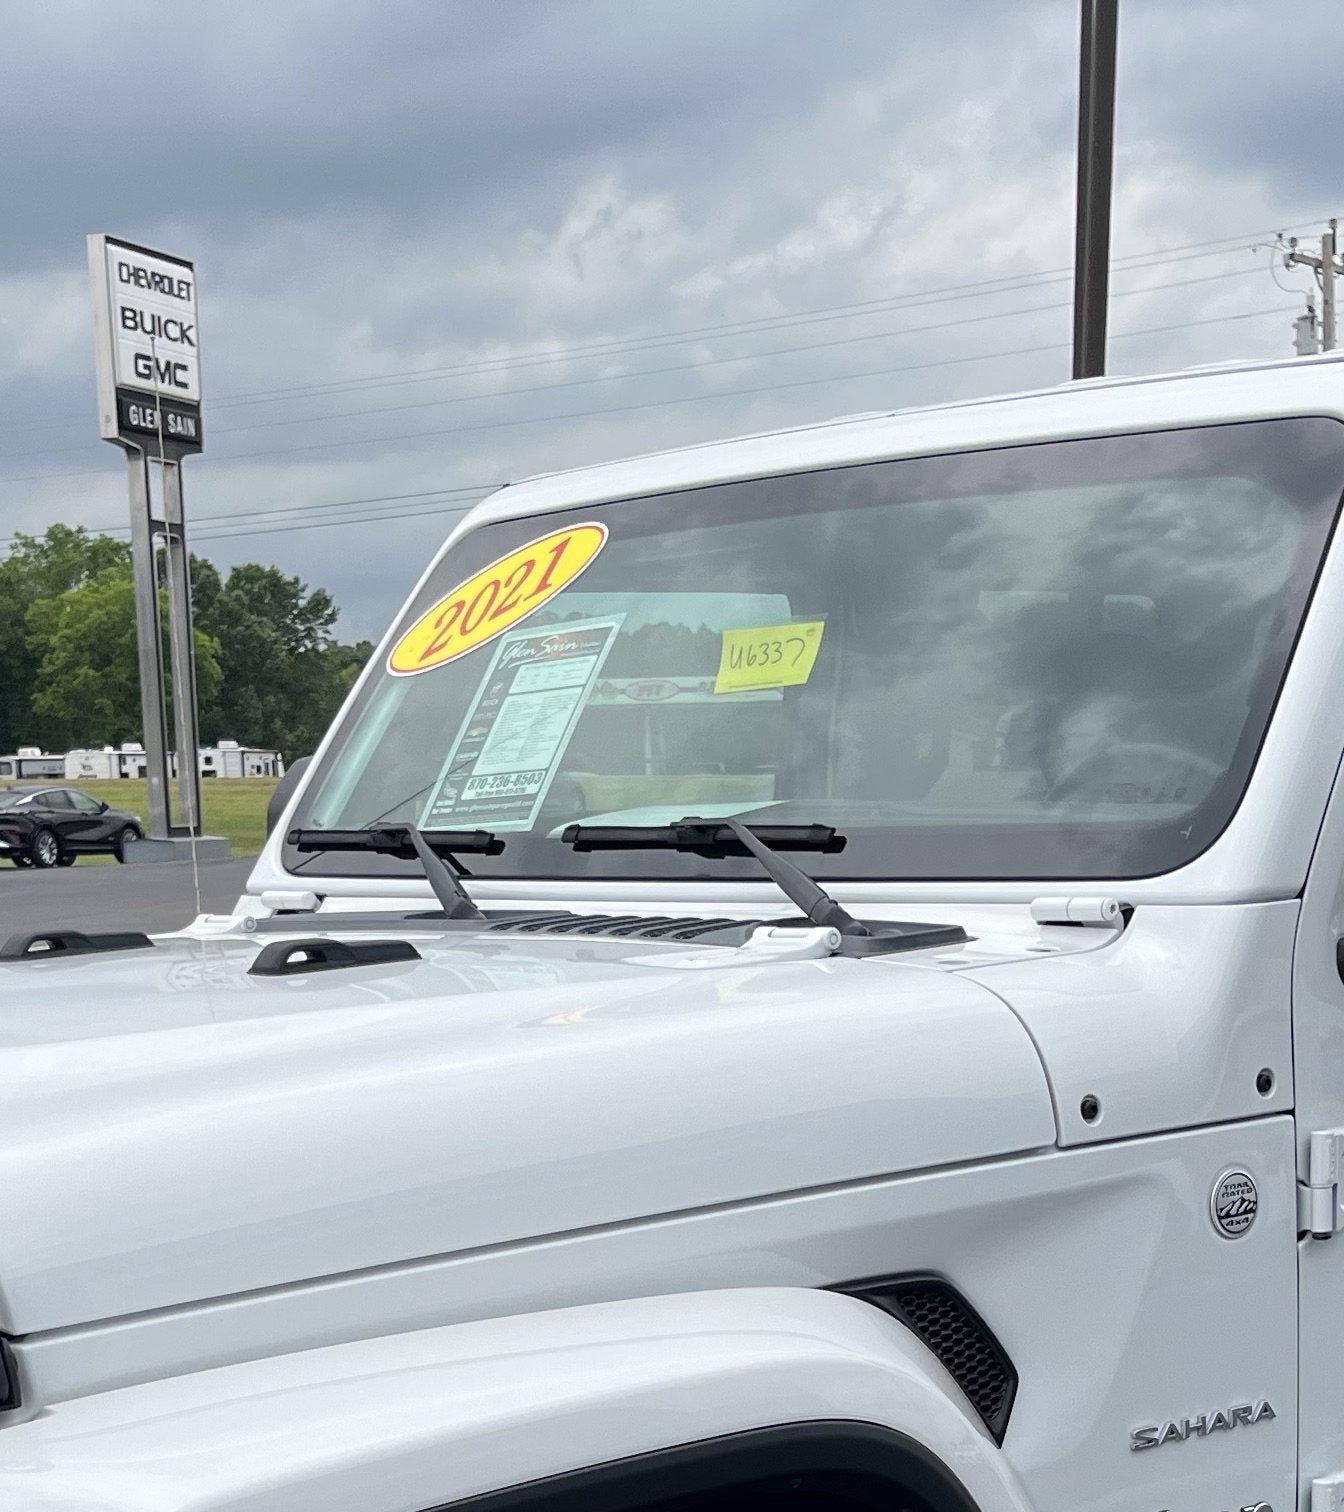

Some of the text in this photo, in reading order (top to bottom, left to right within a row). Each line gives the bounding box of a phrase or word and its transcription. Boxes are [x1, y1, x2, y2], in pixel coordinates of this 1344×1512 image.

[118, 262, 192, 301] CHEVROLET
[120, 306, 196, 347] BUICK
[134, 353, 189, 389] GMC
[167, 413, 197, 437] SAIN
[419, 536, 572, 663] 2021
[467, 773, 543, 791] 870-236-8503
[1222, 1187, 1253, 1198] RATED
[1224, 1181, 1248, 1192] TRAIL
[1130, 1400, 1276, 1451] SAHARA
